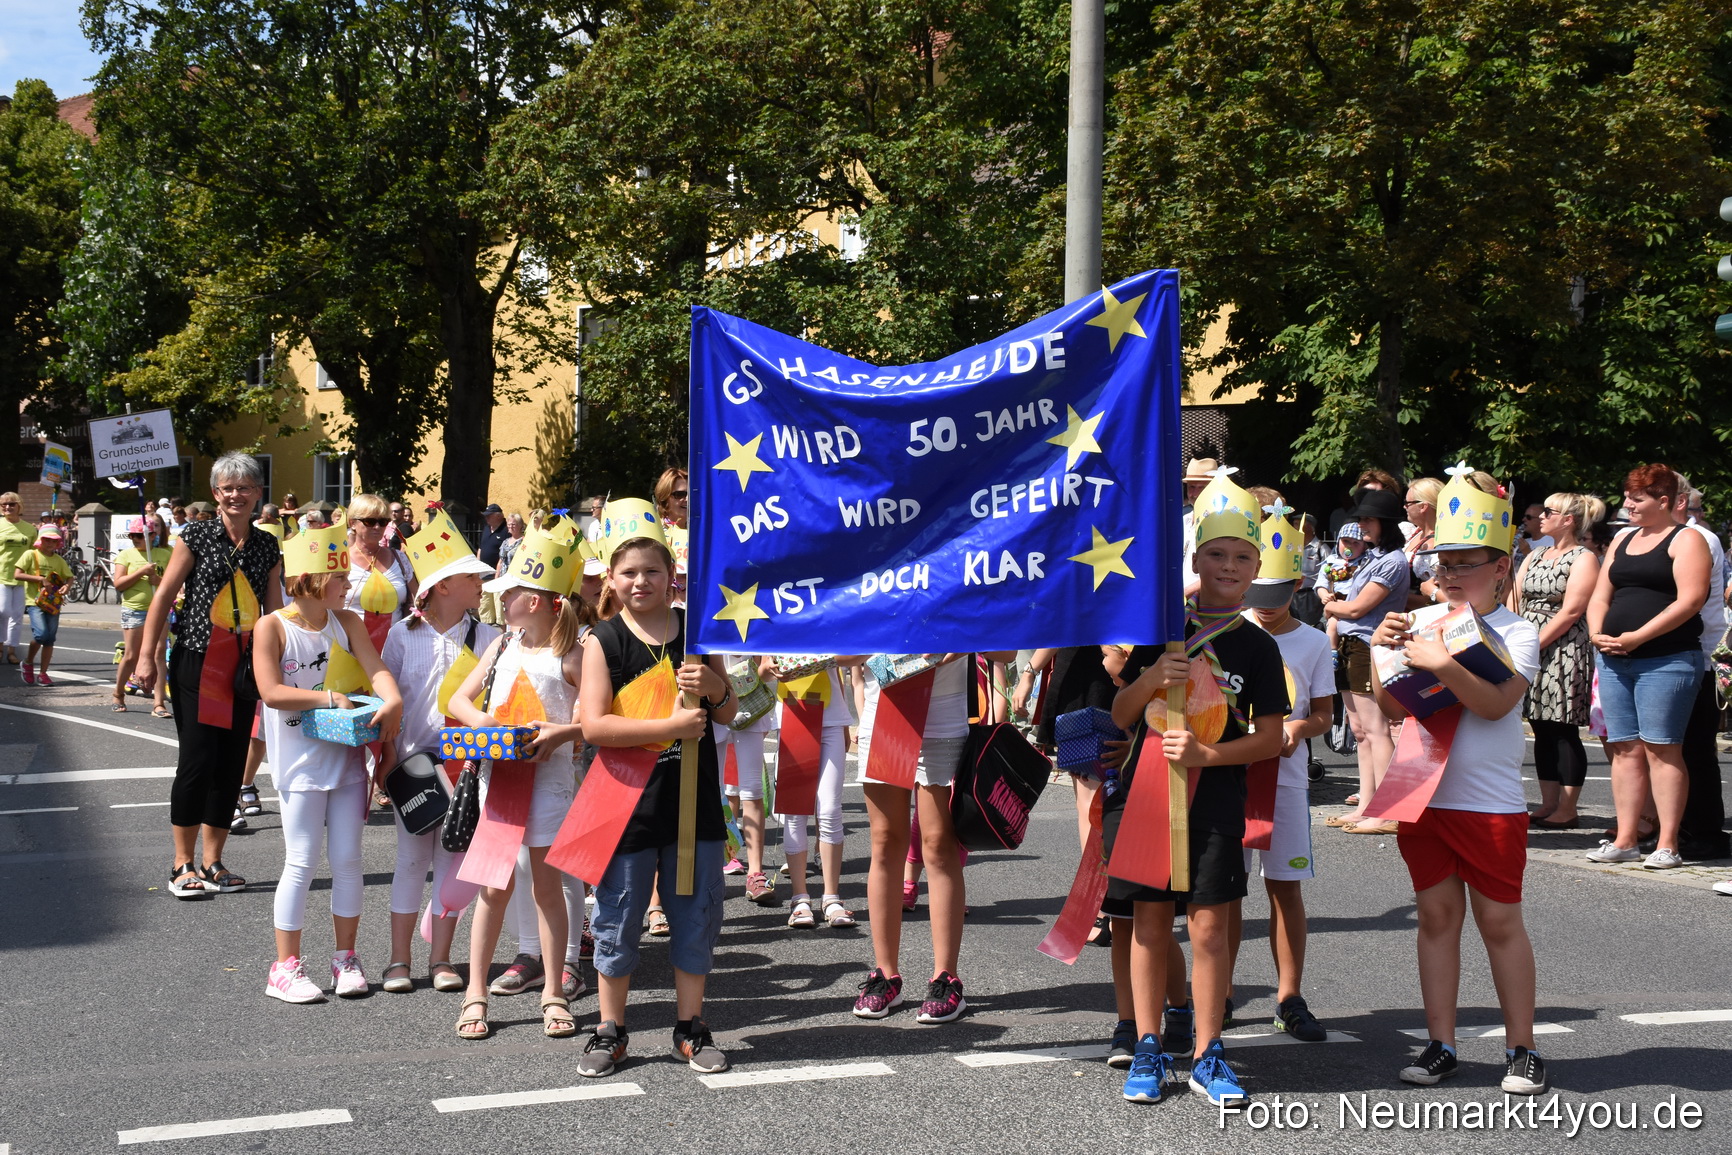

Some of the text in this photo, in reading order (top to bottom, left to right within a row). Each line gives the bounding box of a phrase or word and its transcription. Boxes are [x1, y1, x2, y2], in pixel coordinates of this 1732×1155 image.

[723, 331, 1066, 405] GS HASENHEIDE
[771, 398, 1058, 465] WIRD 50. JAHR
[99, 440, 170, 460] Grundschule
[111, 457, 164, 472] Holzheim
[730, 472, 1115, 543] DAS WIRD GEFEIRT
[619, 520, 638, 538] 50
[1246, 520, 1260, 542] 50
[1463, 521, 1487, 541] 50
[327, 551, 349, 570] 50
[435, 545, 453, 565] 50
[520, 557, 545, 579] 50
[773, 550, 1046, 614] IST DOCH KLAR
[1444, 618, 1477, 641] RACING
[284, 662, 297, 671] NYC
[400, 791, 428, 817] PUMA
